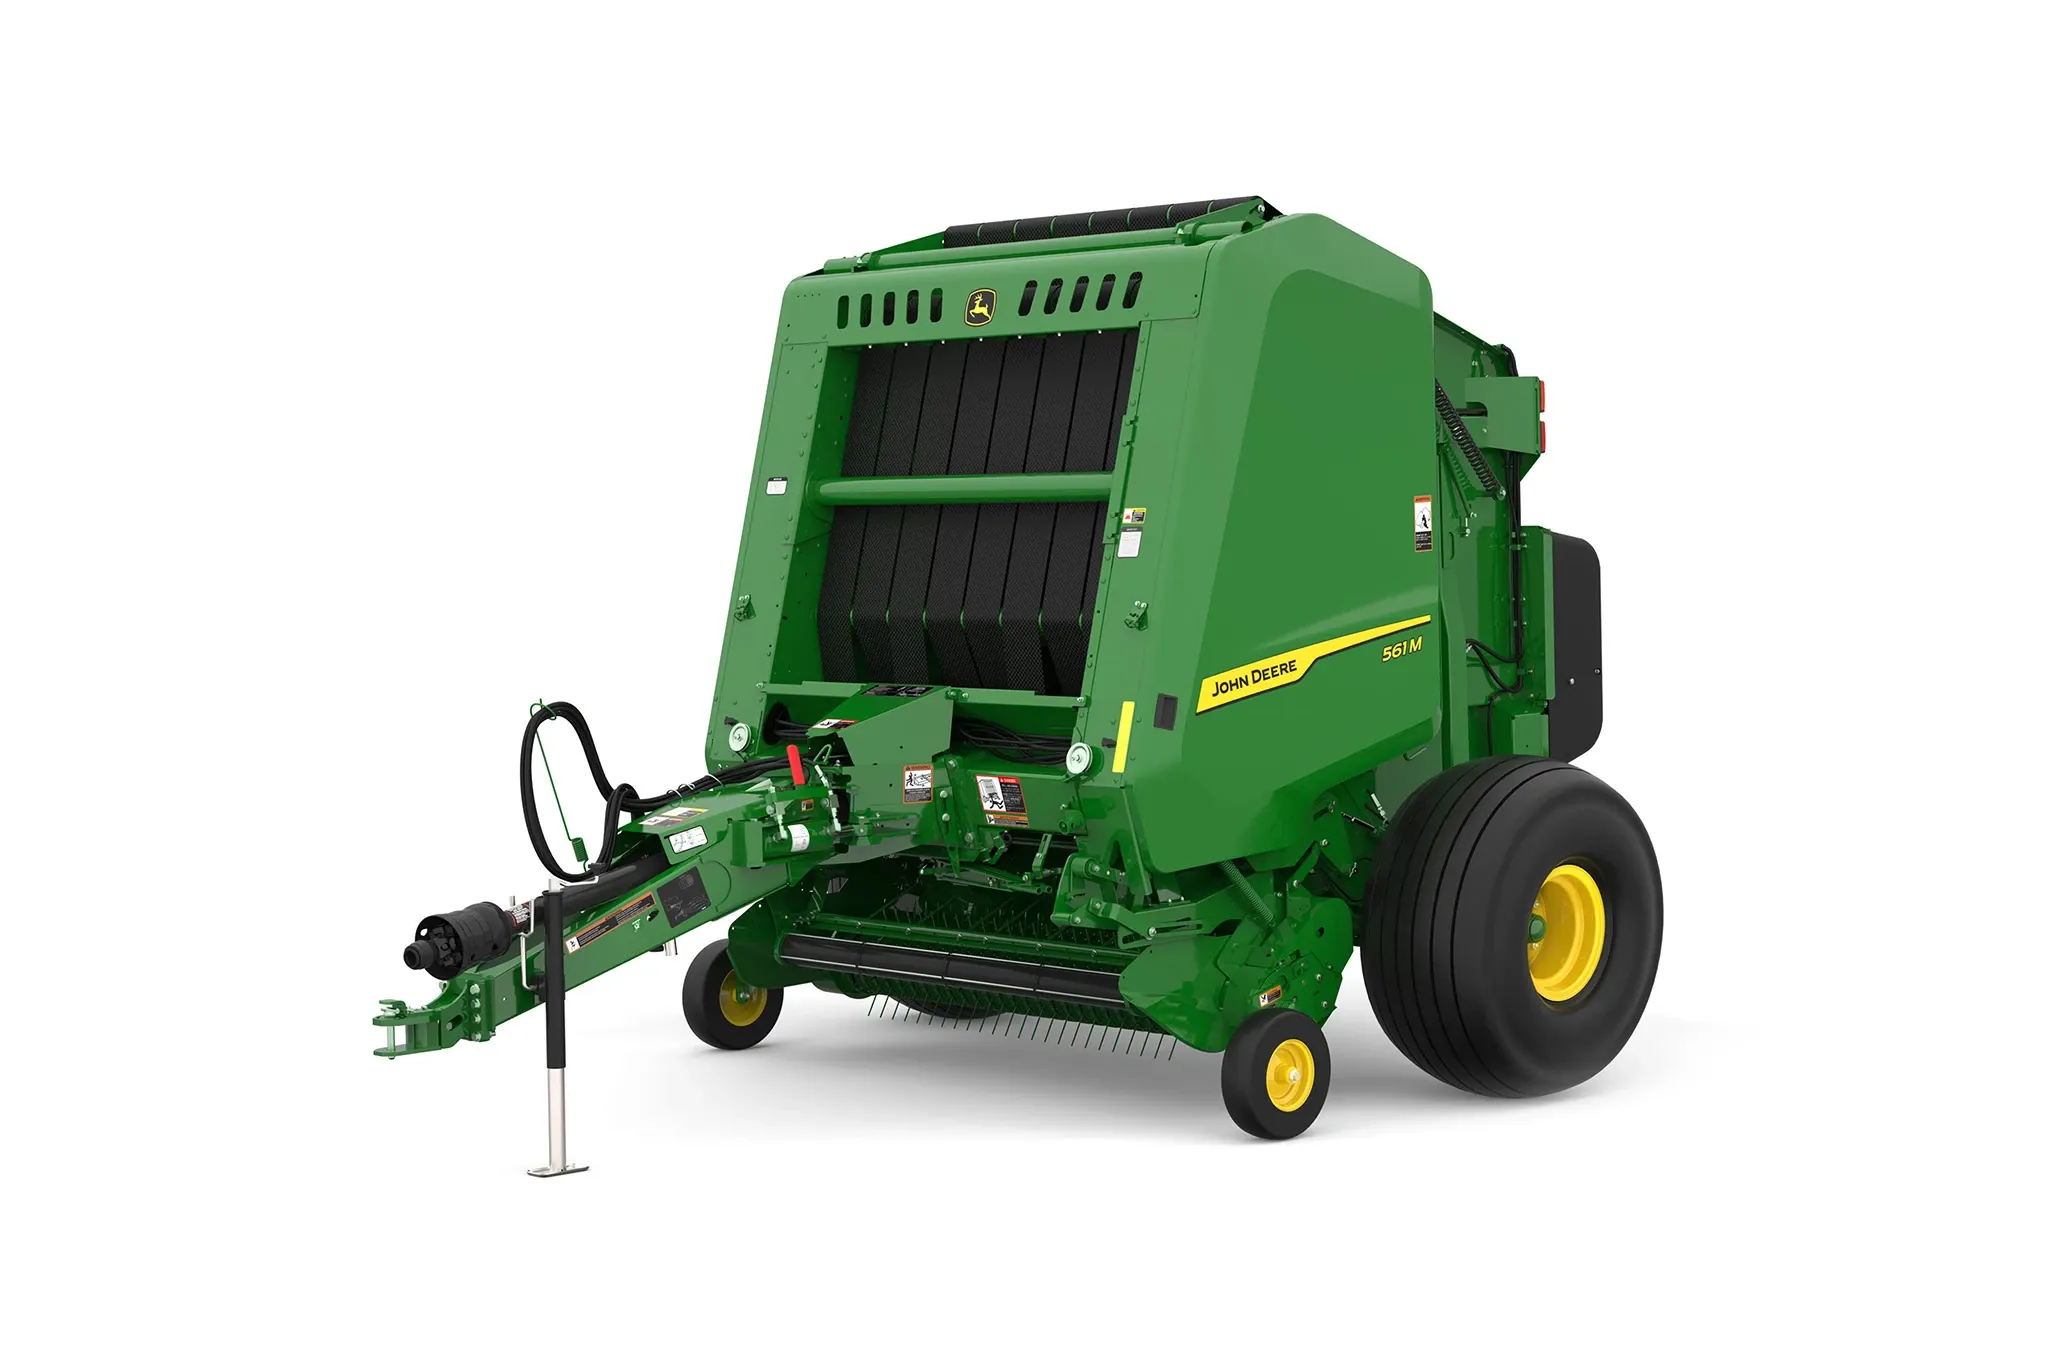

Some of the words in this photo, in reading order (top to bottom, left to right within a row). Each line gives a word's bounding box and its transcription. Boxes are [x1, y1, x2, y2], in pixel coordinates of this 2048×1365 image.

[1382, 640, 1407, 663] 561
[1409, 636, 1423, 652] M
[1212, 675, 1249, 697] JOHN
[1252, 660, 1297, 684] DEERE
